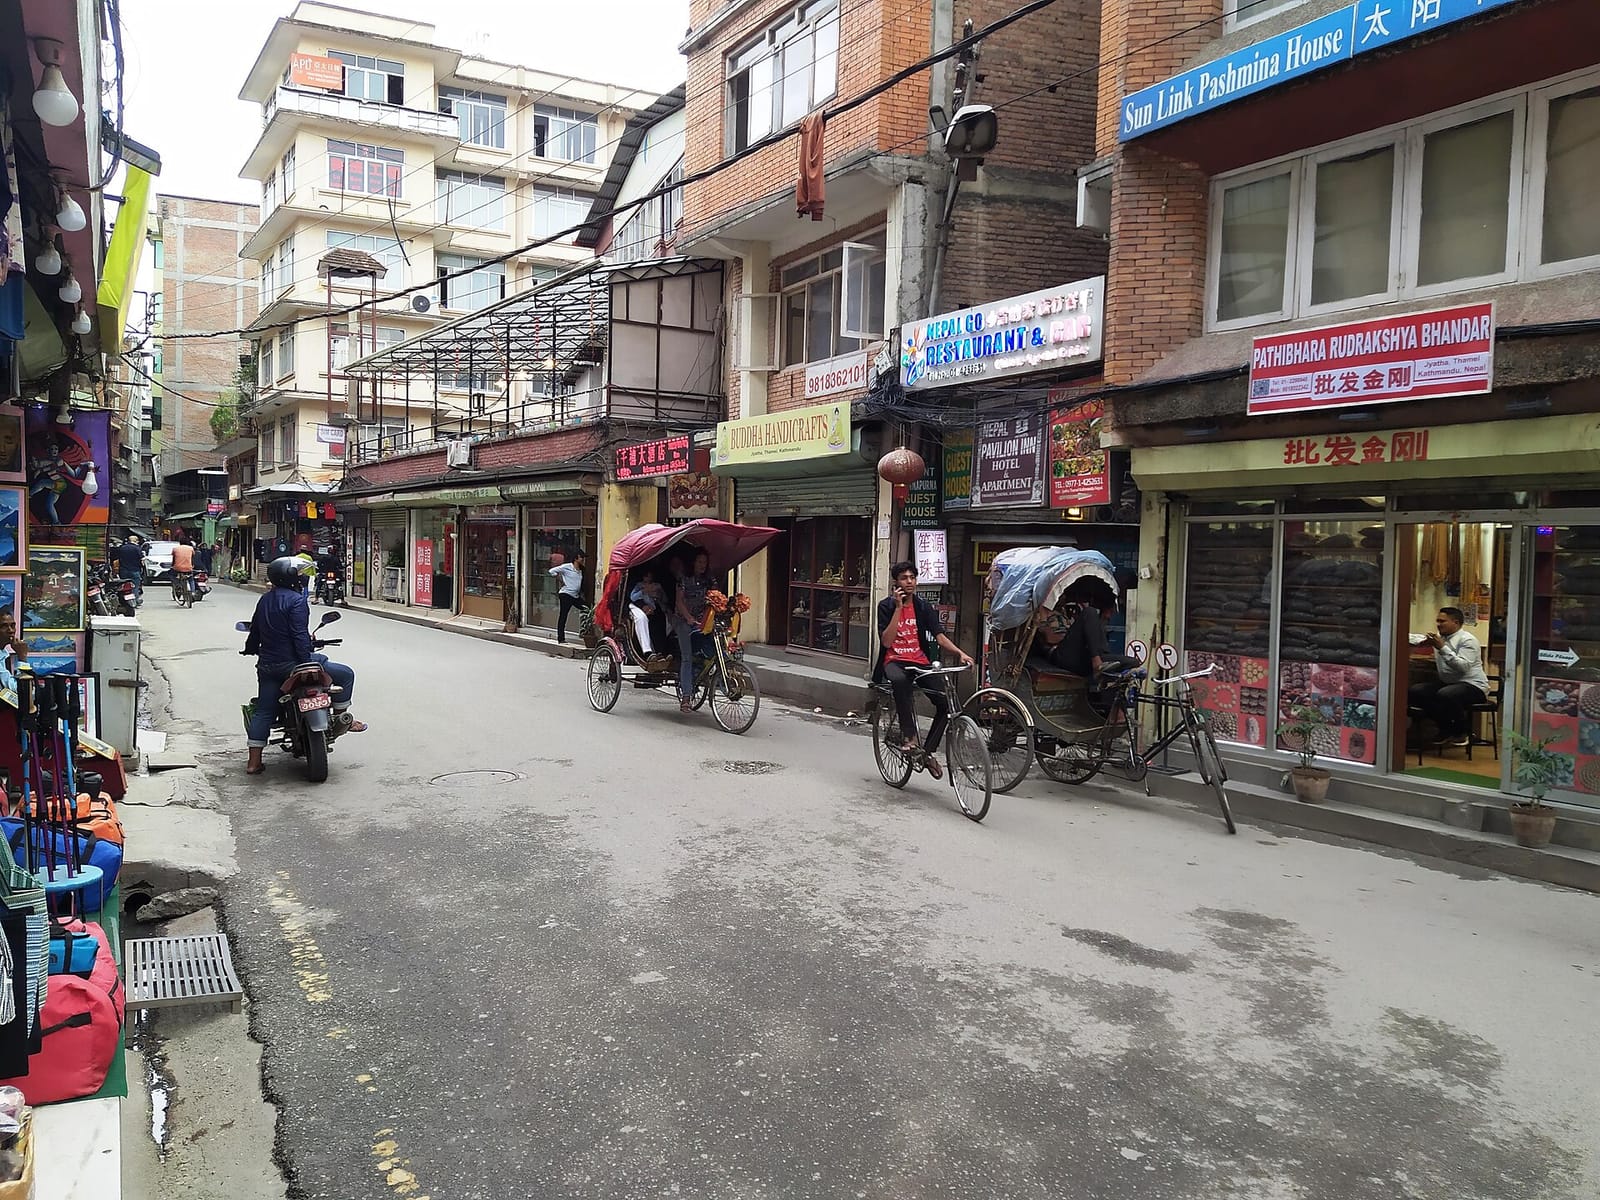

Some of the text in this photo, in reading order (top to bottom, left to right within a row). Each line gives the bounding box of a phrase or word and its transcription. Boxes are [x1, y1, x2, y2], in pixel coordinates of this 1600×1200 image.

[1123, 28, 1343, 133] Sun Link Pashmina House
[926, 312, 983, 341] NEPAL GO
[926, 326, 1028, 367] RESTAURANT
[1031, 326, 1046, 347] &
[1253, 315, 1490, 370] PATHIBHARA RUDRAKSHYA BHANDAR
[808, 364, 865, 394] 9818362101
[1314, 364, 1412, 396] 批发金刚
[1464, 364, 1486, 373] Nepal
[731, 414, 828, 450] BUDDHA HANDICRAFTS
[983, 421, 1008, 438] NEPAL
[981, 436, 1037, 460] PAVILION INN
[1284, 430, 1429, 466] 批发金刚
[946, 452, 971, 473] GUEST
[992, 459, 1021, 471] HOTEL
[981, 478, 1032, 491] APARTMENT
[905, 494, 936, 504] GUEST
[905, 507, 936, 517] HOUSE
[919, 559, 946, 580] 珠宝
